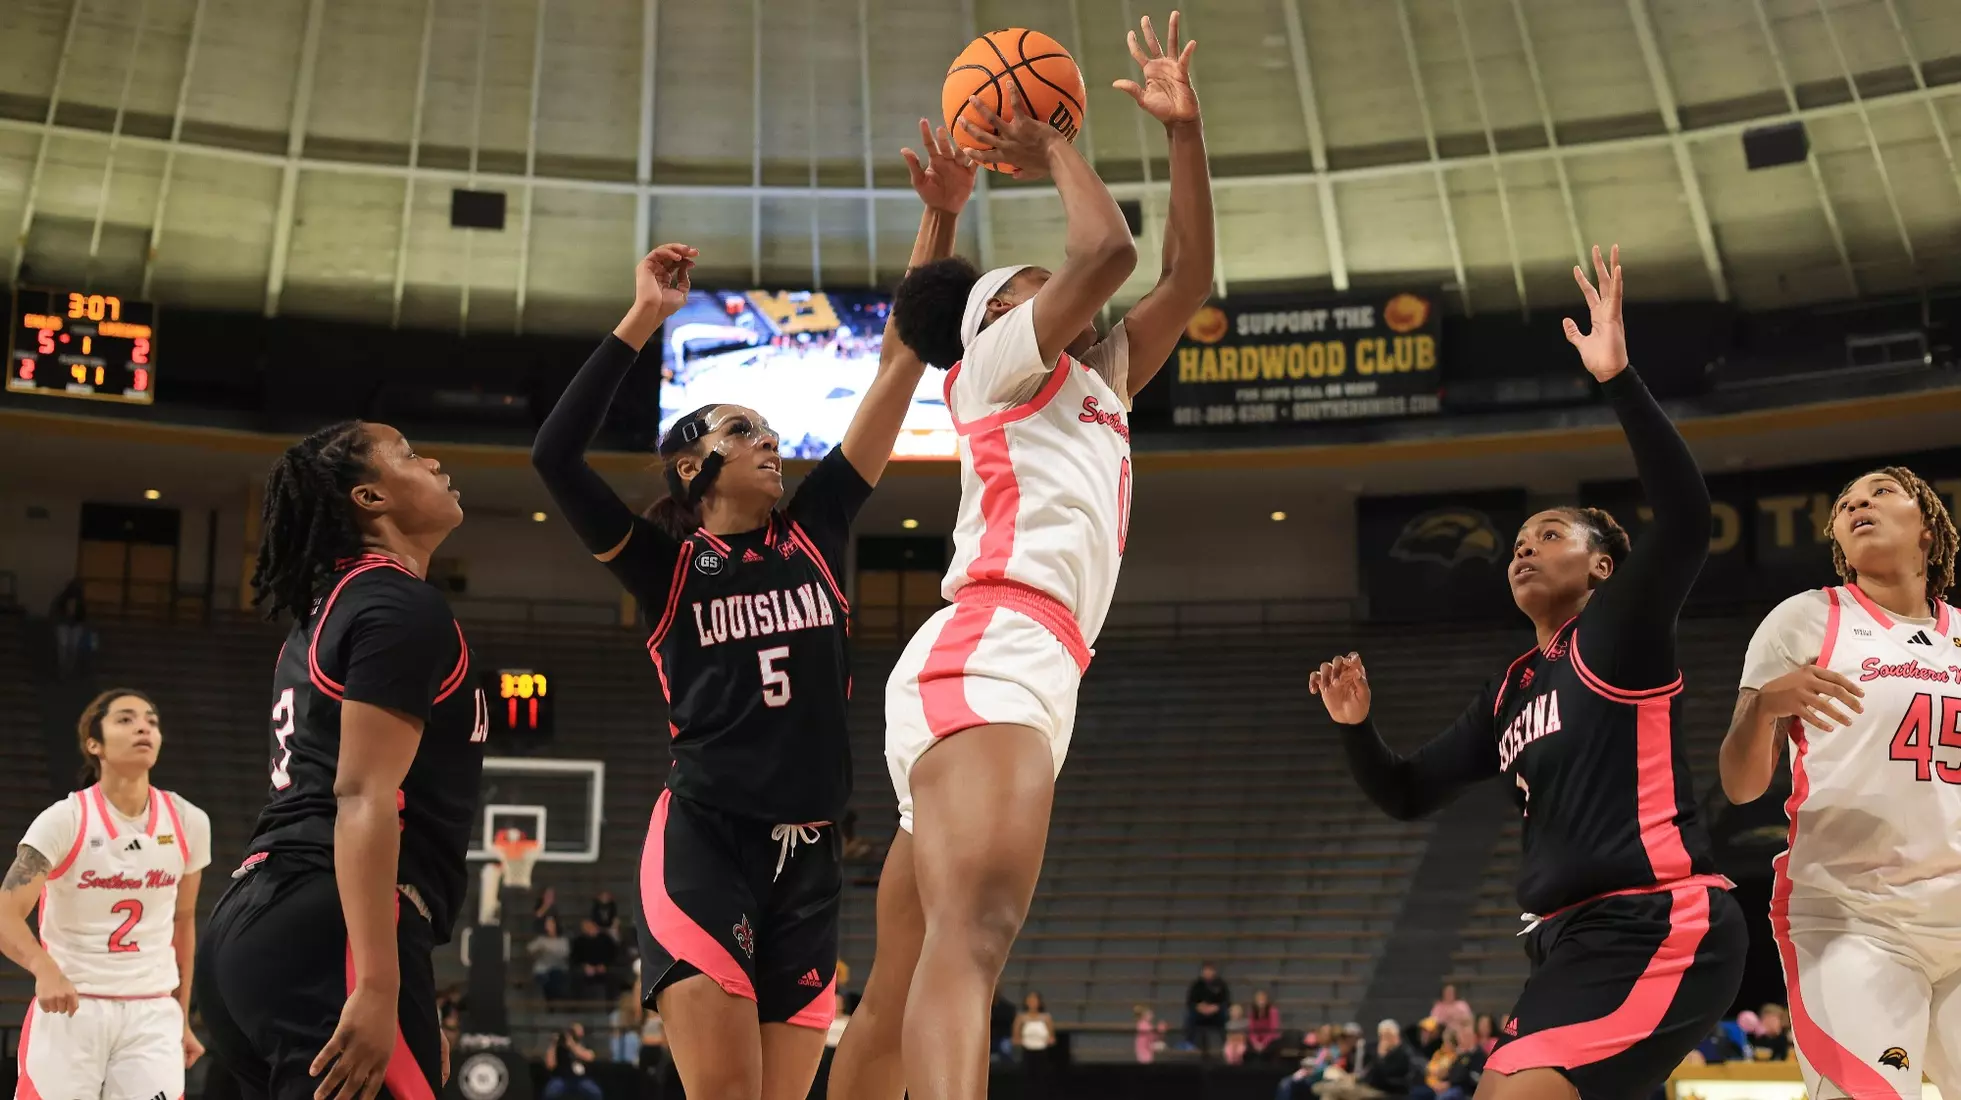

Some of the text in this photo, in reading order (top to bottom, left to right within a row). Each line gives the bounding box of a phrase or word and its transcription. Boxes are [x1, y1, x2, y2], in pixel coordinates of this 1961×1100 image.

[1049, 101, 1078, 144] Wil
[68, 293, 120, 321] 3:07
[1236, 306, 1375, 336] SUPPORT THE
[132, 338, 150, 364] 2
[1178, 335, 1436, 383] HARDWOOD CLUB
[700, 556, 718, 568] GS
[693, 582, 834, 647] LOUISIANA
[757, 646, 792, 708] 5
[1860, 657, 1949, 683] Southern
[501, 673, 547, 698] 3:07
[508, 698, 538, 729] 11
[1889, 692, 1961, 784] 45
[77, 868, 176, 889] Southern Miss
[108, 899, 143, 953] 2
